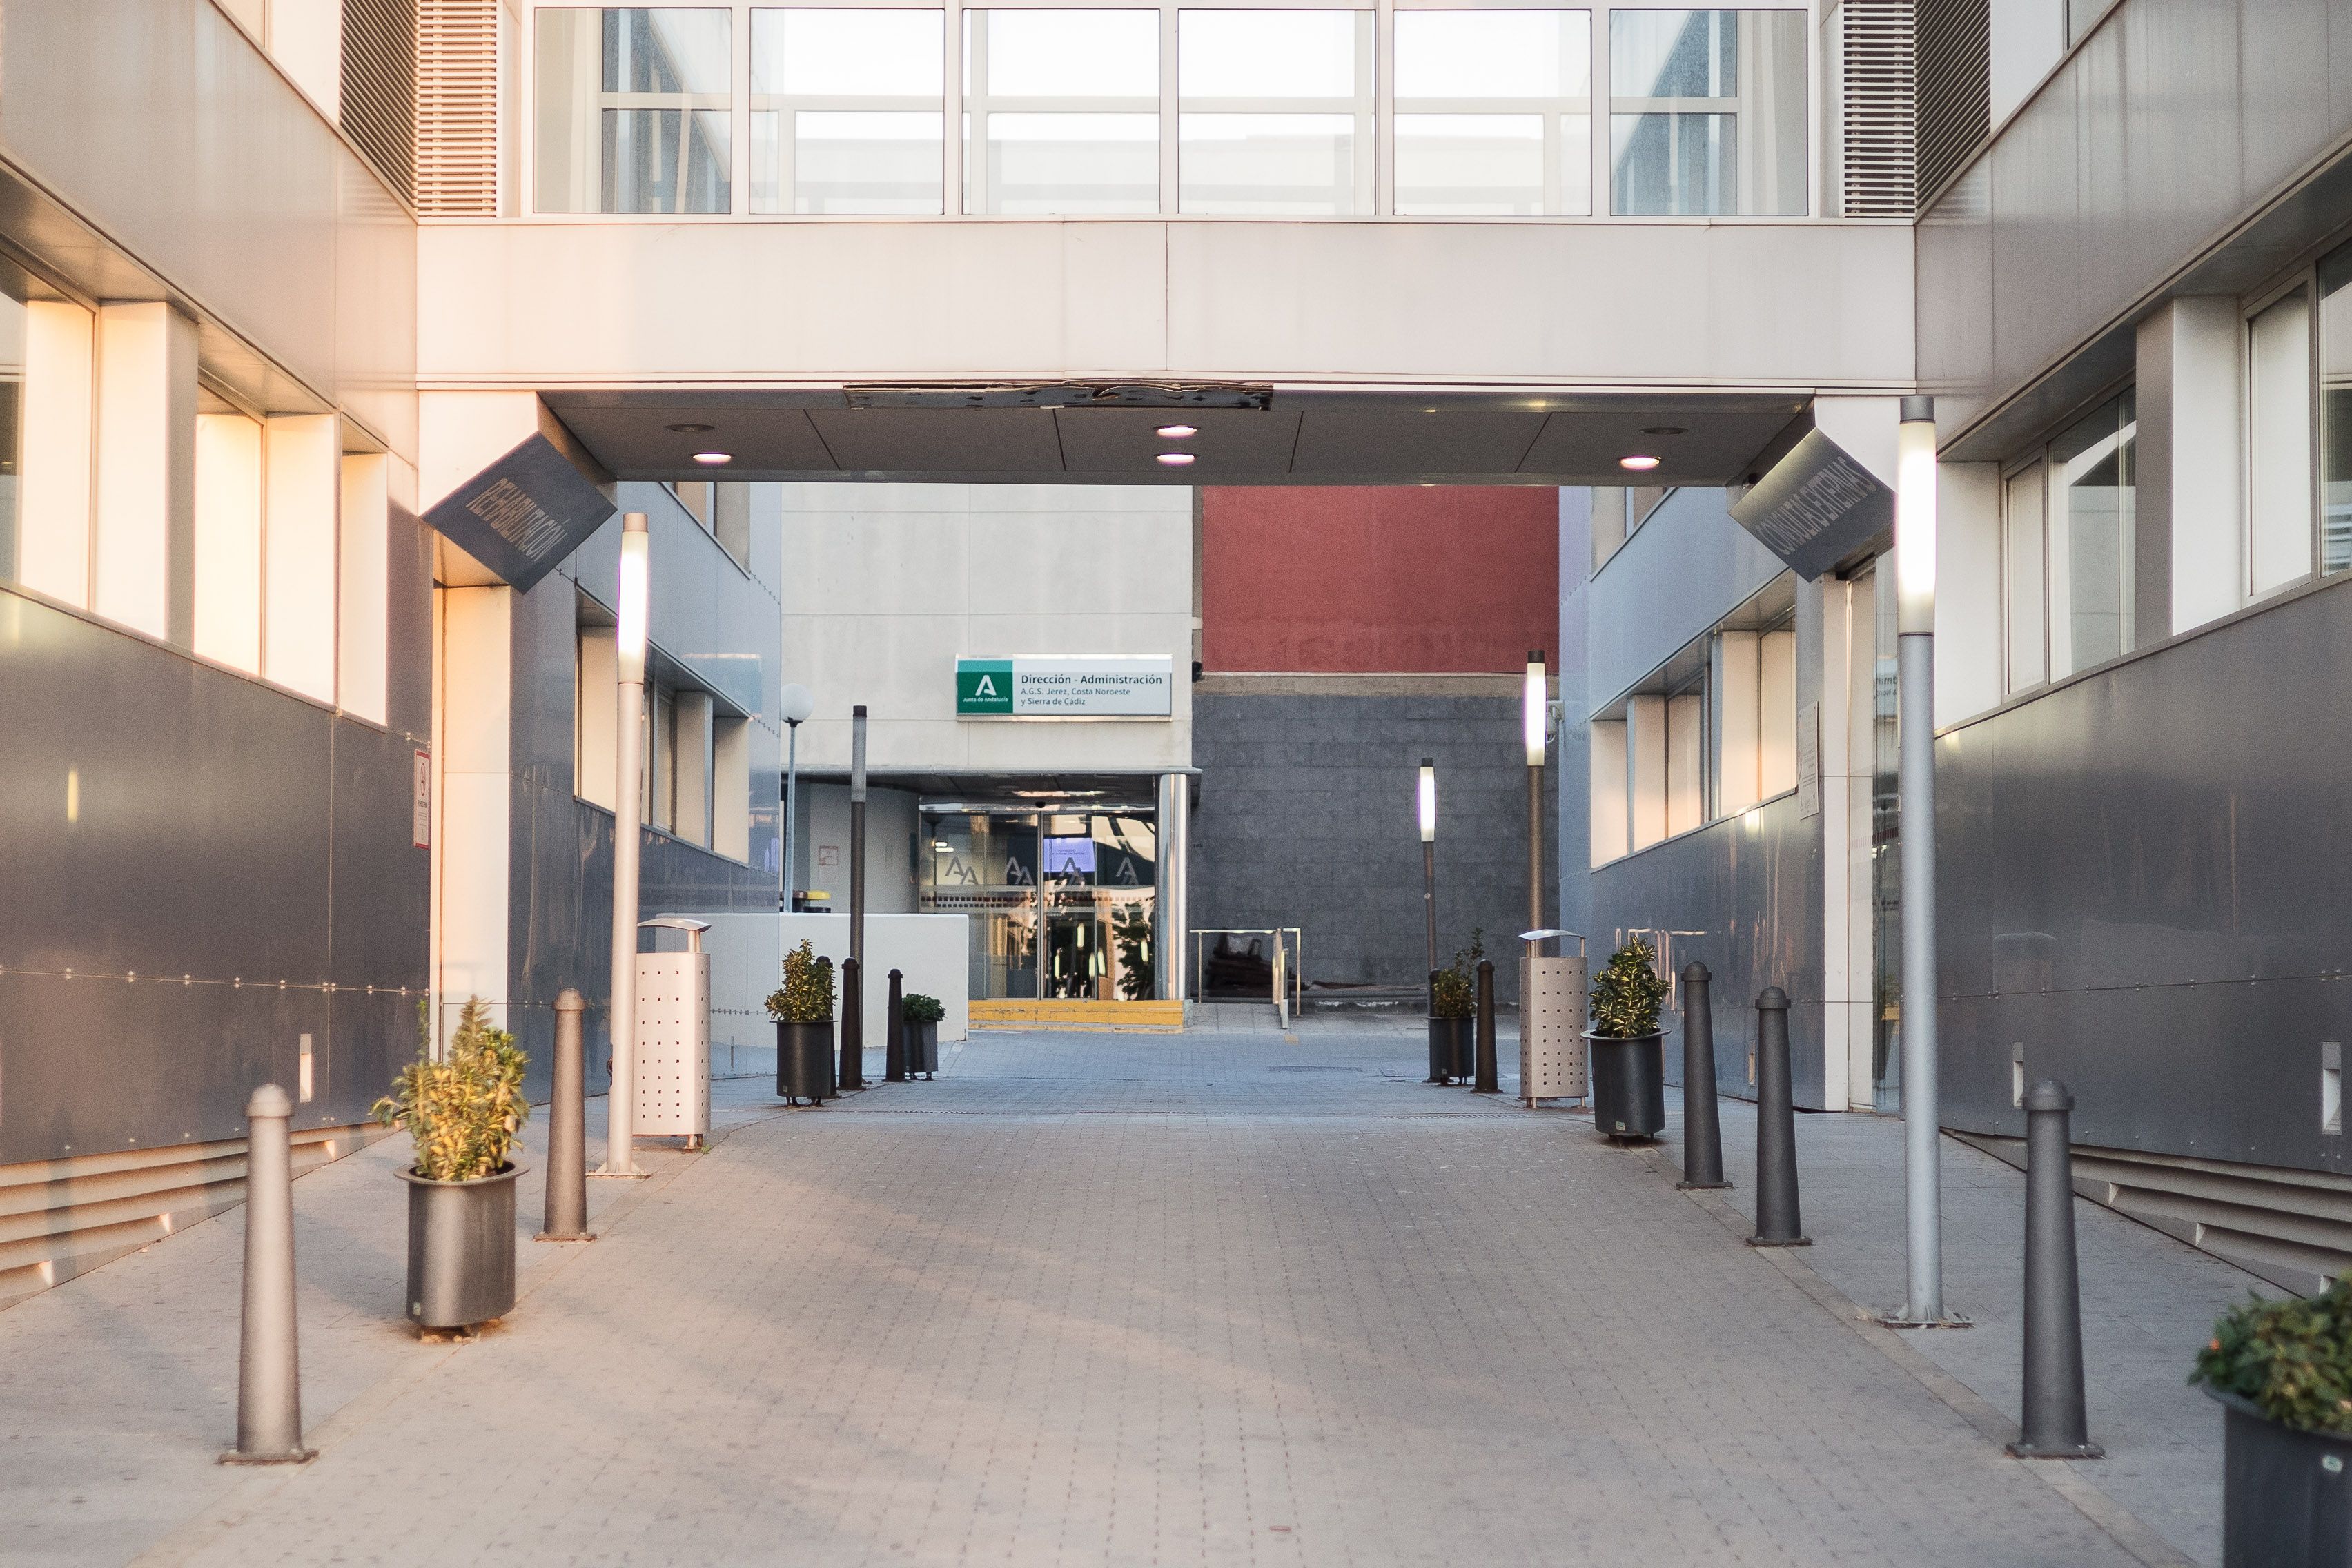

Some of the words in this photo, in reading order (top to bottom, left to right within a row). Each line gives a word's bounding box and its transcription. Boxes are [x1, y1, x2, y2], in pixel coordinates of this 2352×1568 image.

[1755, 492, 1830, 555] CONSULTAS
[1801, 456, 1877, 521] EXTERNAS
[1021, 674, 1071, 684] Dirección
[1080, 674, 1162, 684] Administración
[1046, 687, 1070, 696] Jerez,
[1064, 697, 1086, 705] Cádiz
